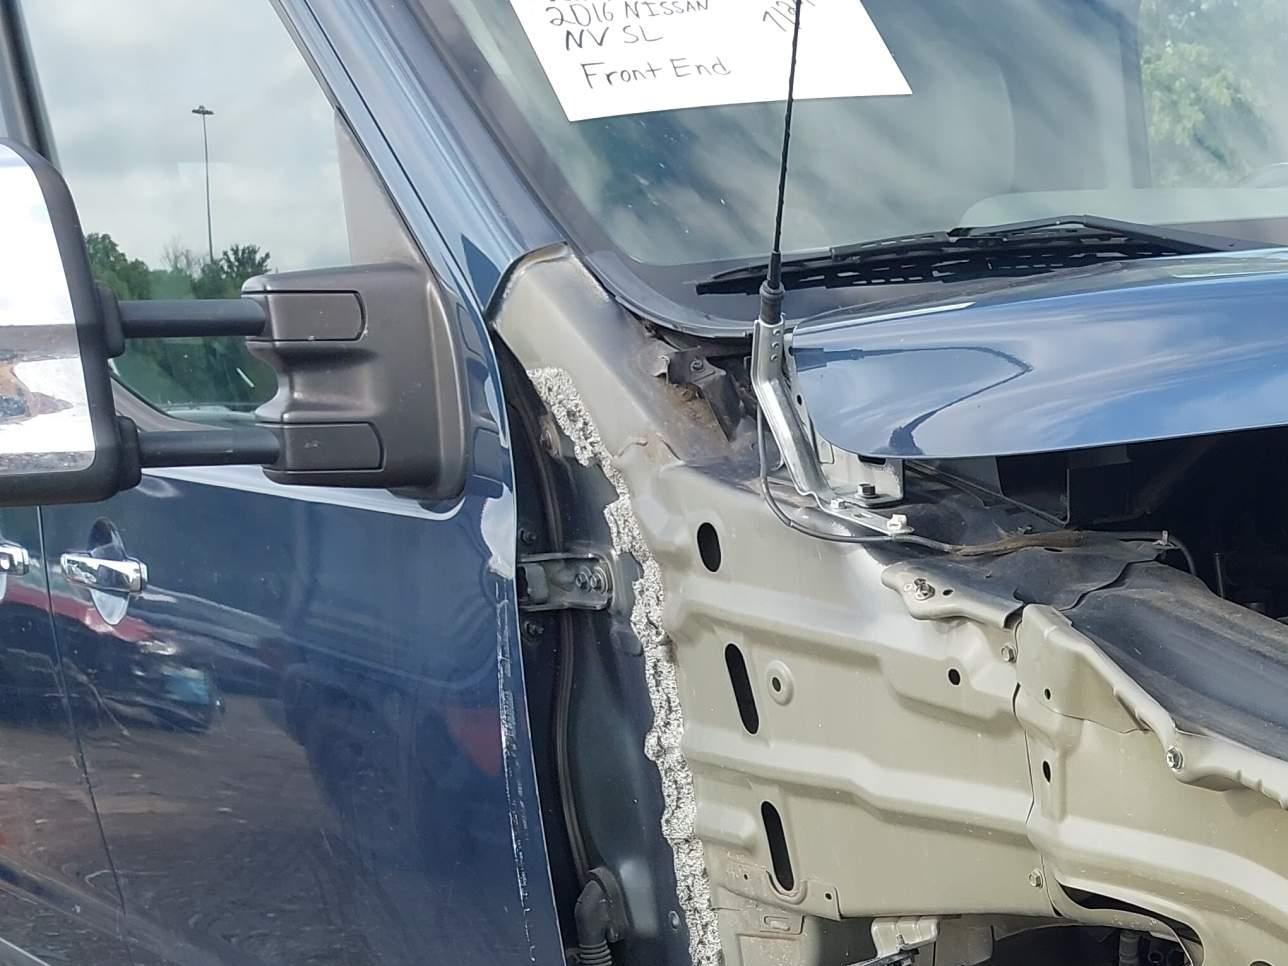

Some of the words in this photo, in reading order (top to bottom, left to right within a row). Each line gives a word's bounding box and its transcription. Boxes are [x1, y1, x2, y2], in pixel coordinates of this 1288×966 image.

[545, 3, 614, 27] 2016
[624, 0, 709, 18] NISSAN
[565, 26, 610, 51] NV
[622, 25, 663, 44] SL
[580, 61, 663, 89] Front
[669, 56, 731, 78] End
